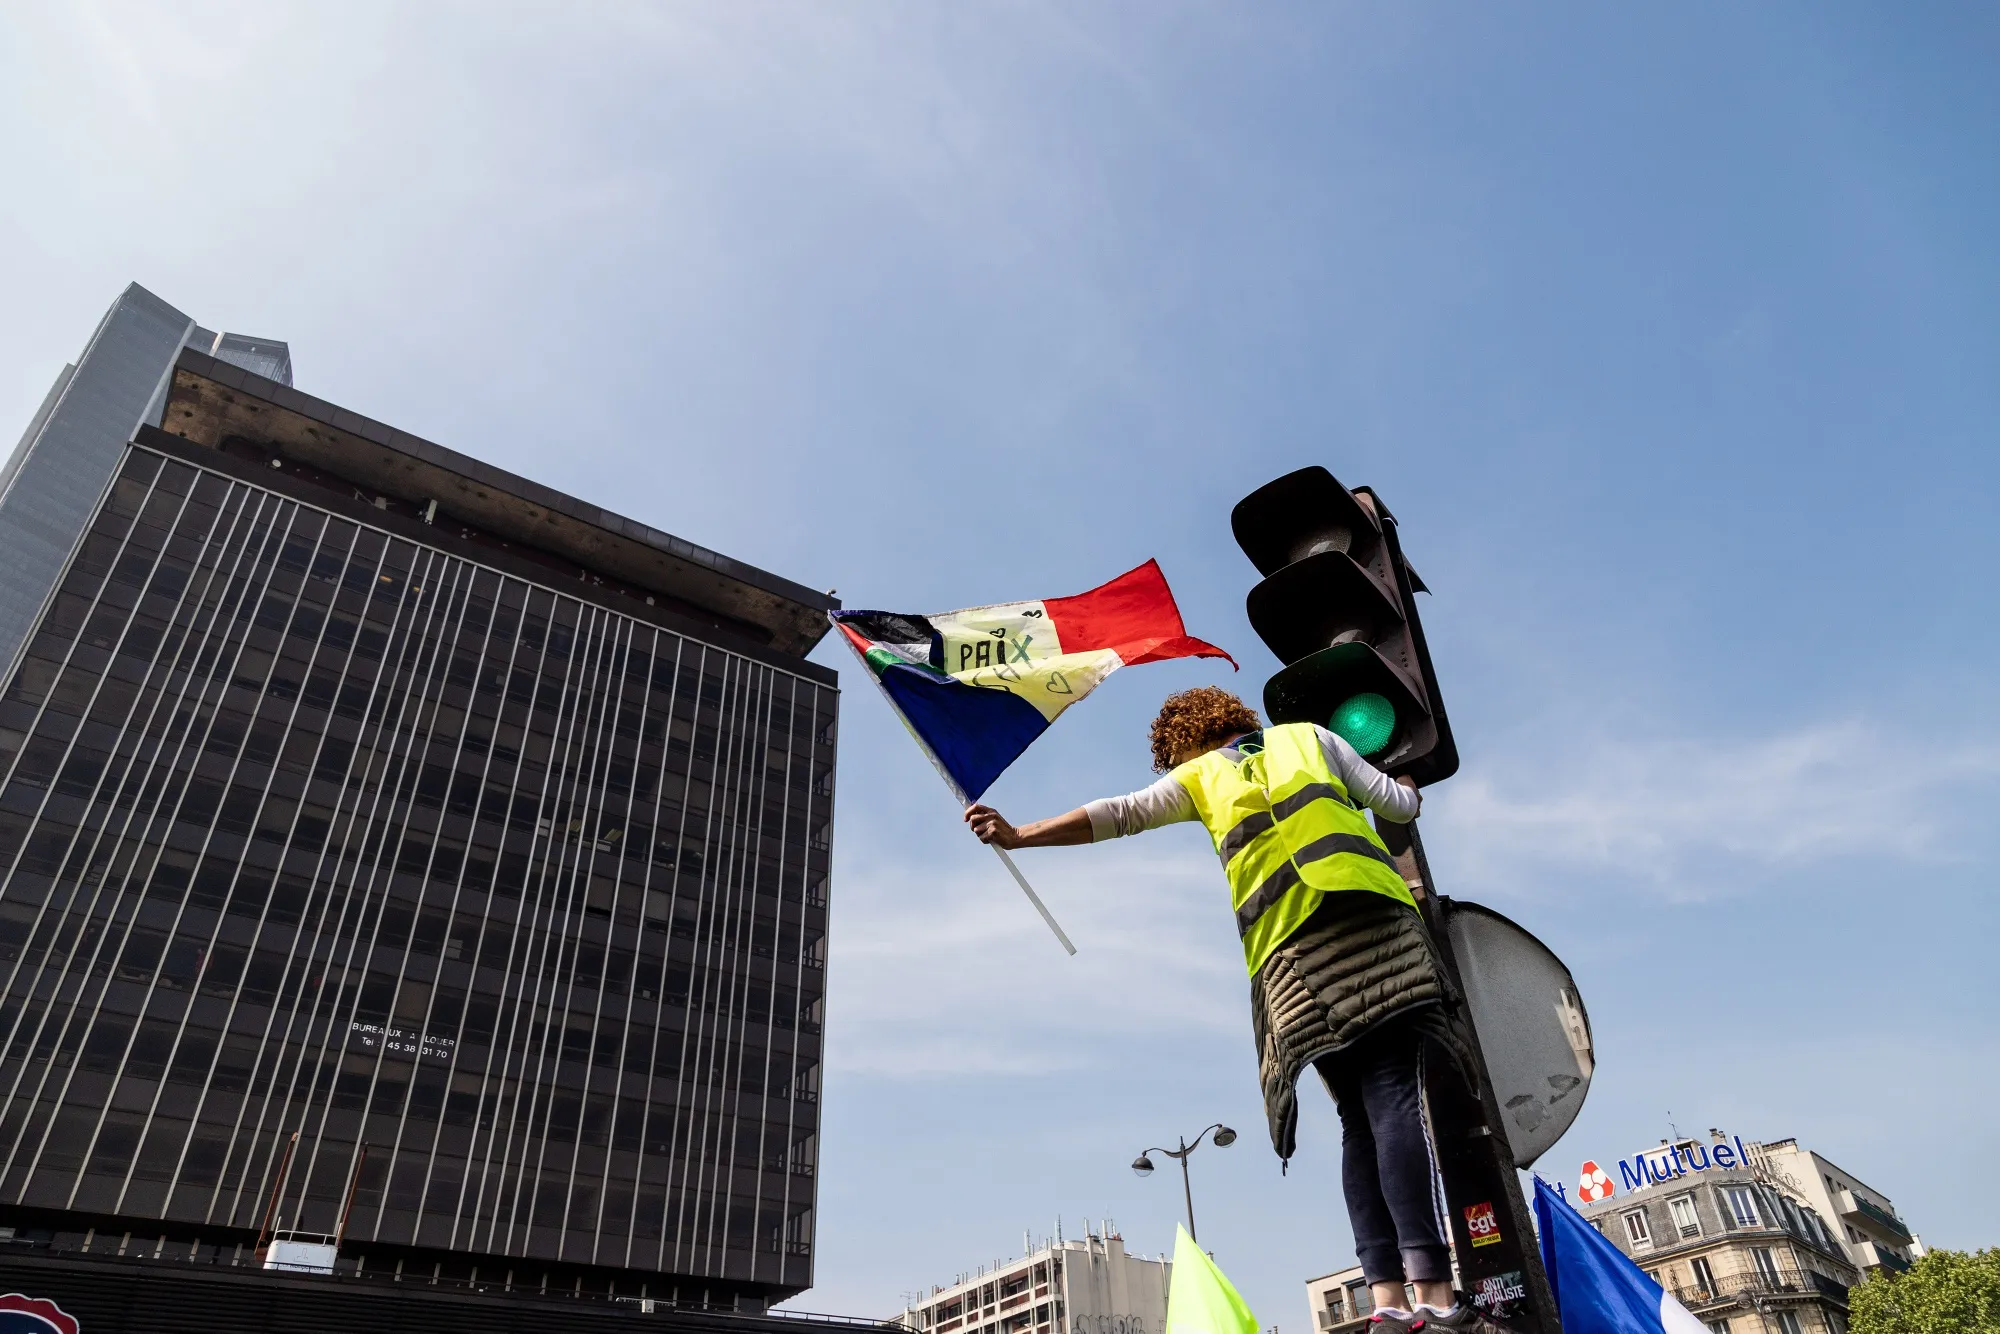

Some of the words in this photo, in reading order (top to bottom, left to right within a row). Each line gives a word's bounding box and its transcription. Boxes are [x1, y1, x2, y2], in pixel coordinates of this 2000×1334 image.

[352, 1022, 402, 1037] BUREAUX
[424, 1035, 455, 1047] LOUER
[387, 1041, 400, 1050] 45
[404, 1044, 416, 1053] 38
[422, 1047, 433, 1056] 31
[436, 1049, 447, 1058] 70
[1618, 1135, 1749, 1191] Mutuel
[1468, 1211, 1497, 1234] cgt
[1473, 1284, 1526, 1306] APITALISTE
[1483, 1276, 1505, 1293] ANTI
